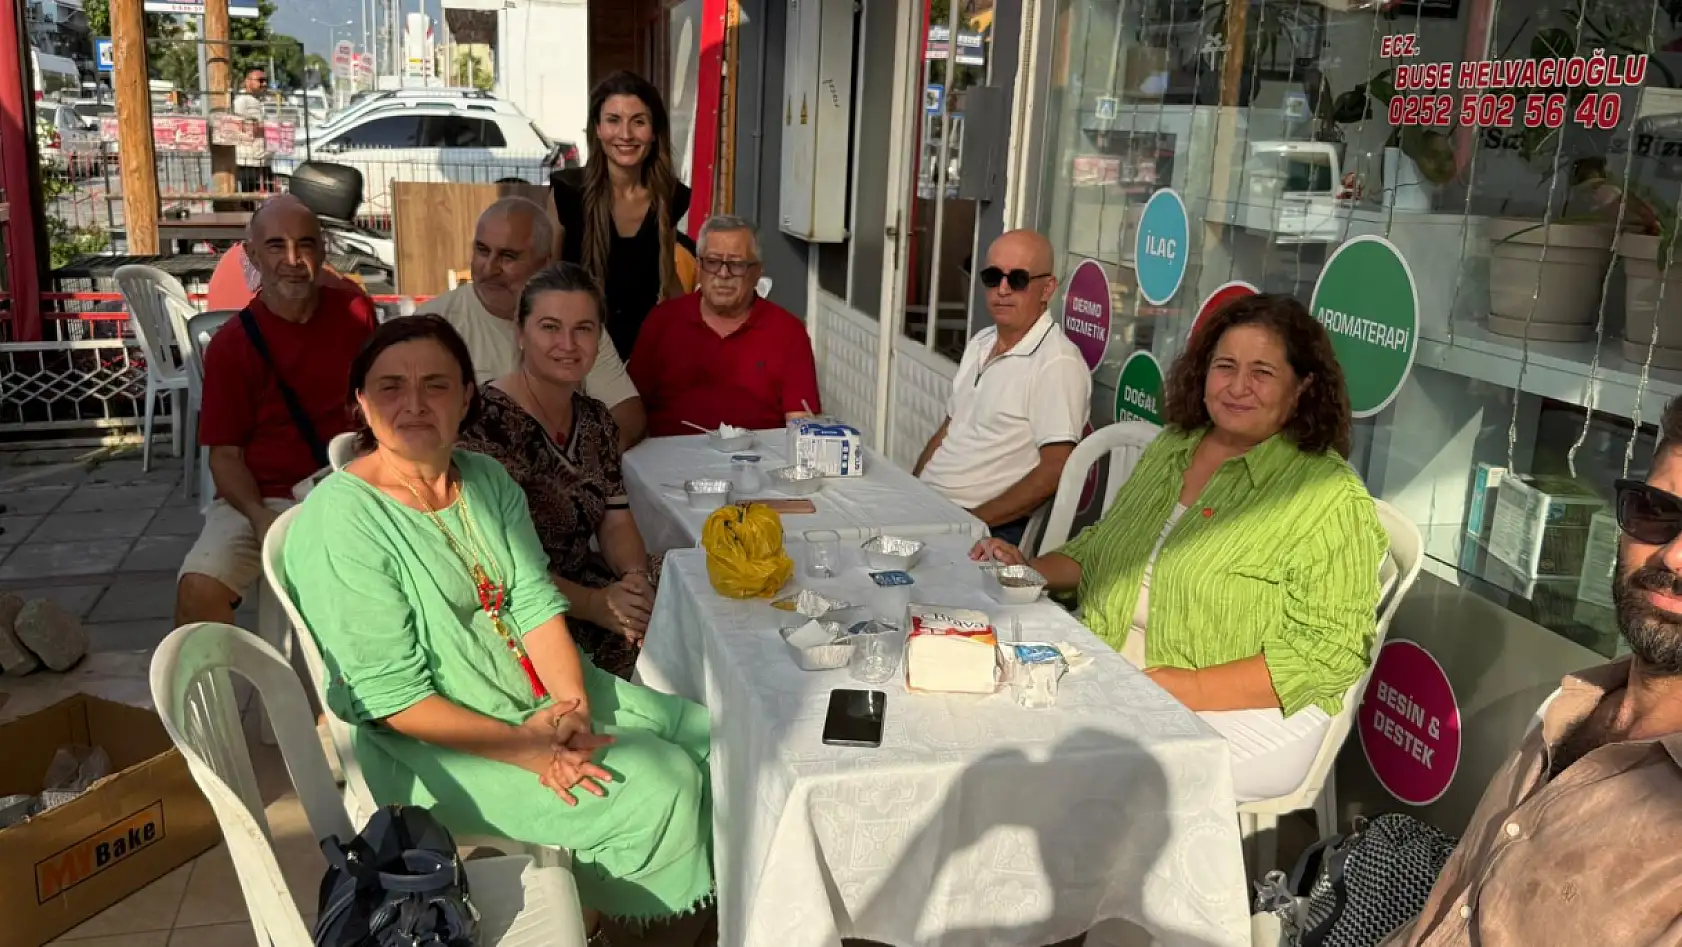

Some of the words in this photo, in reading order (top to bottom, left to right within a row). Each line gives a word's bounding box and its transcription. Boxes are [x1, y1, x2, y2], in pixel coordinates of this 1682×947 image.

[1381, 33, 1420, 58] ECZ.
[1395, 63, 1453, 90] BUSE
[1458, 48, 1648, 88] HELVACIOĞLU
[1388, 94, 1453, 126] 0252
[1460, 94, 1516, 127] 502
[1524, 93, 1566, 128] 56
[1573, 92, 1622, 129] 40
[1145, 230, 1177, 265] İLAÇ
[1072, 297, 1102, 318] DERMO
[1065, 315, 1106, 341] KOZMETİK
[1316, 307, 1410, 353] AROMATERAPİ
[1124, 384, 1157, 414] DOĞAL
[1376, 680, 1426, 729] BESİN
[1428, 716, 1440, 740] &
[1373, 709, 1435, 770] DESTEK
